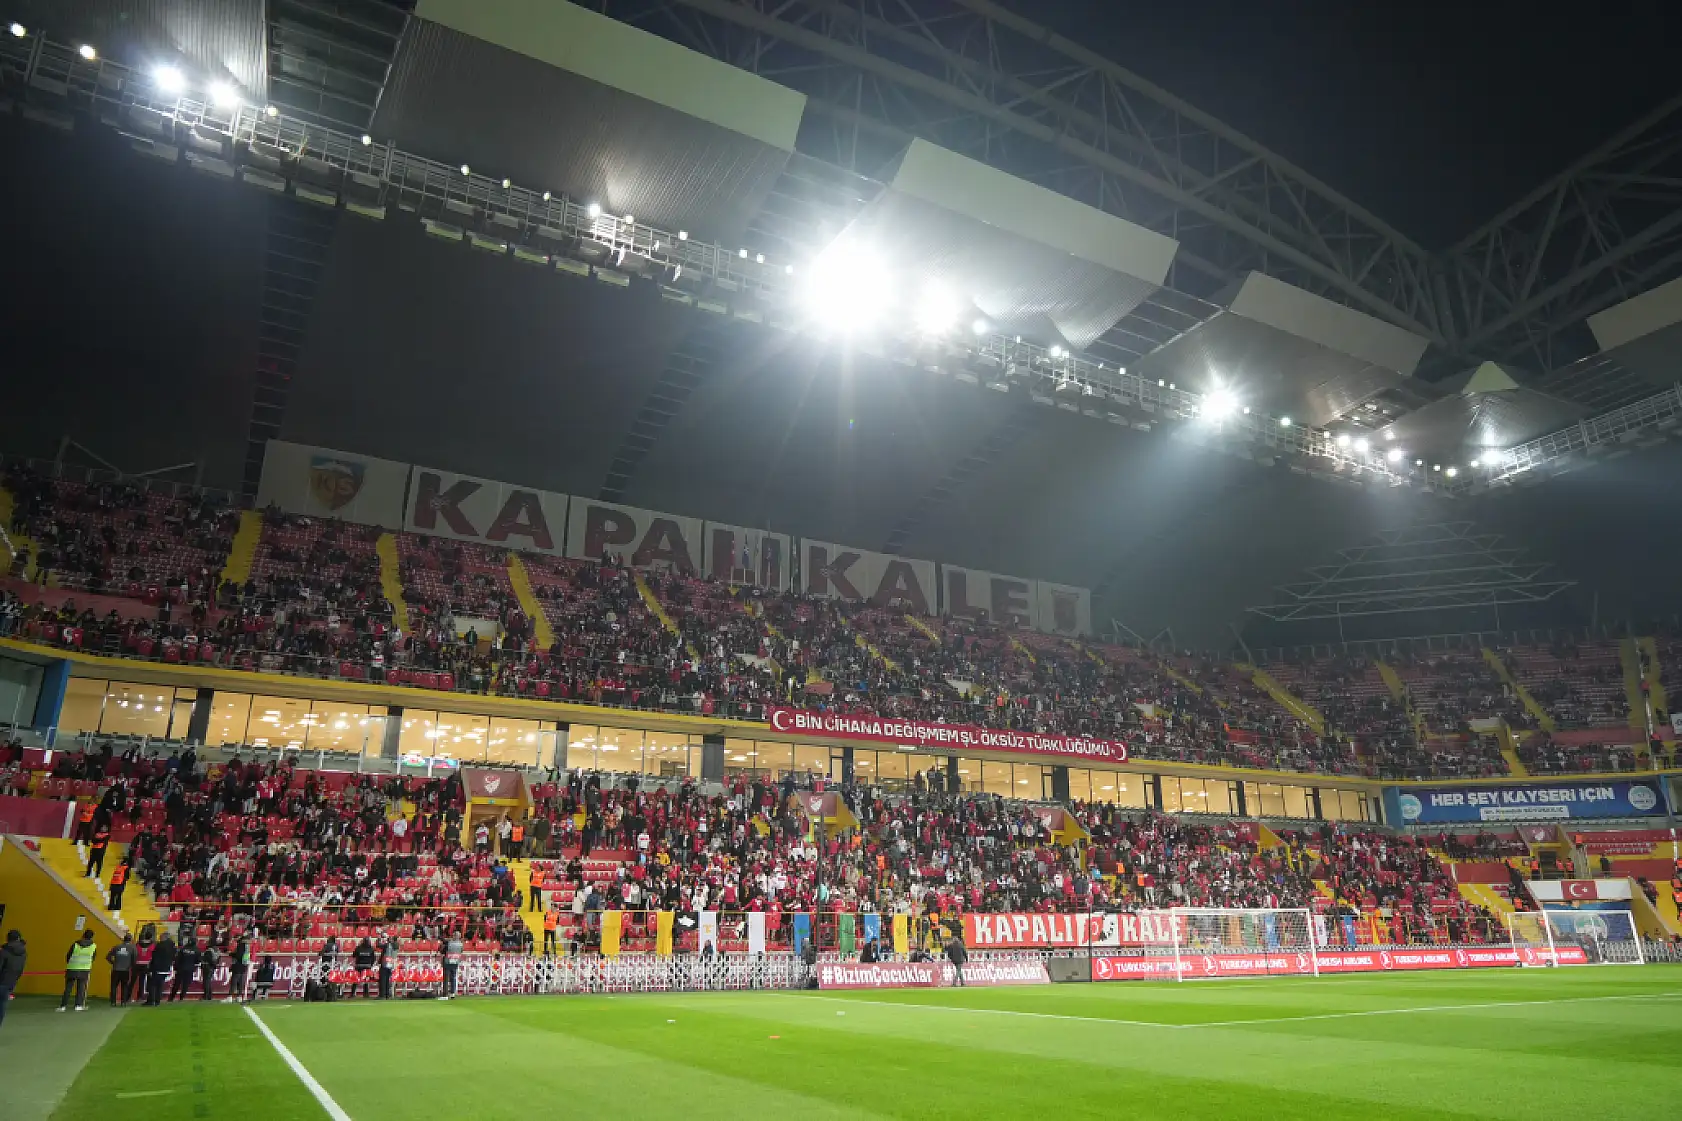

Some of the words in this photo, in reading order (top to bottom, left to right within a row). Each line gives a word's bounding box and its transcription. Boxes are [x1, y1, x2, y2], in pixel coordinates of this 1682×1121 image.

[807, 545, 1031, 626] KALE
[796, 712, 823, 730] BİN
[825, 715, 882, 735] CİHANA
[884, 721, 958, 744] DEĞİŞMEM
[981, 729, 1027, 749] ÖKSÜZ
[1027, 735, 1111, 756] TÜRKLÜĞÜMÜ
[1431, 793, 1465, 807] HER
[1468, 791, 1499, 807] ŞEY
[974, 913, 1073, 944] KAPALI
[1122, 915, 1184, 942] KALE
[1114, 961, 1153, 973] TURKISH
[1217, 959, 1253, 969] TURKISH
[821, 965, 933, 986] #BizimÇocuklar
